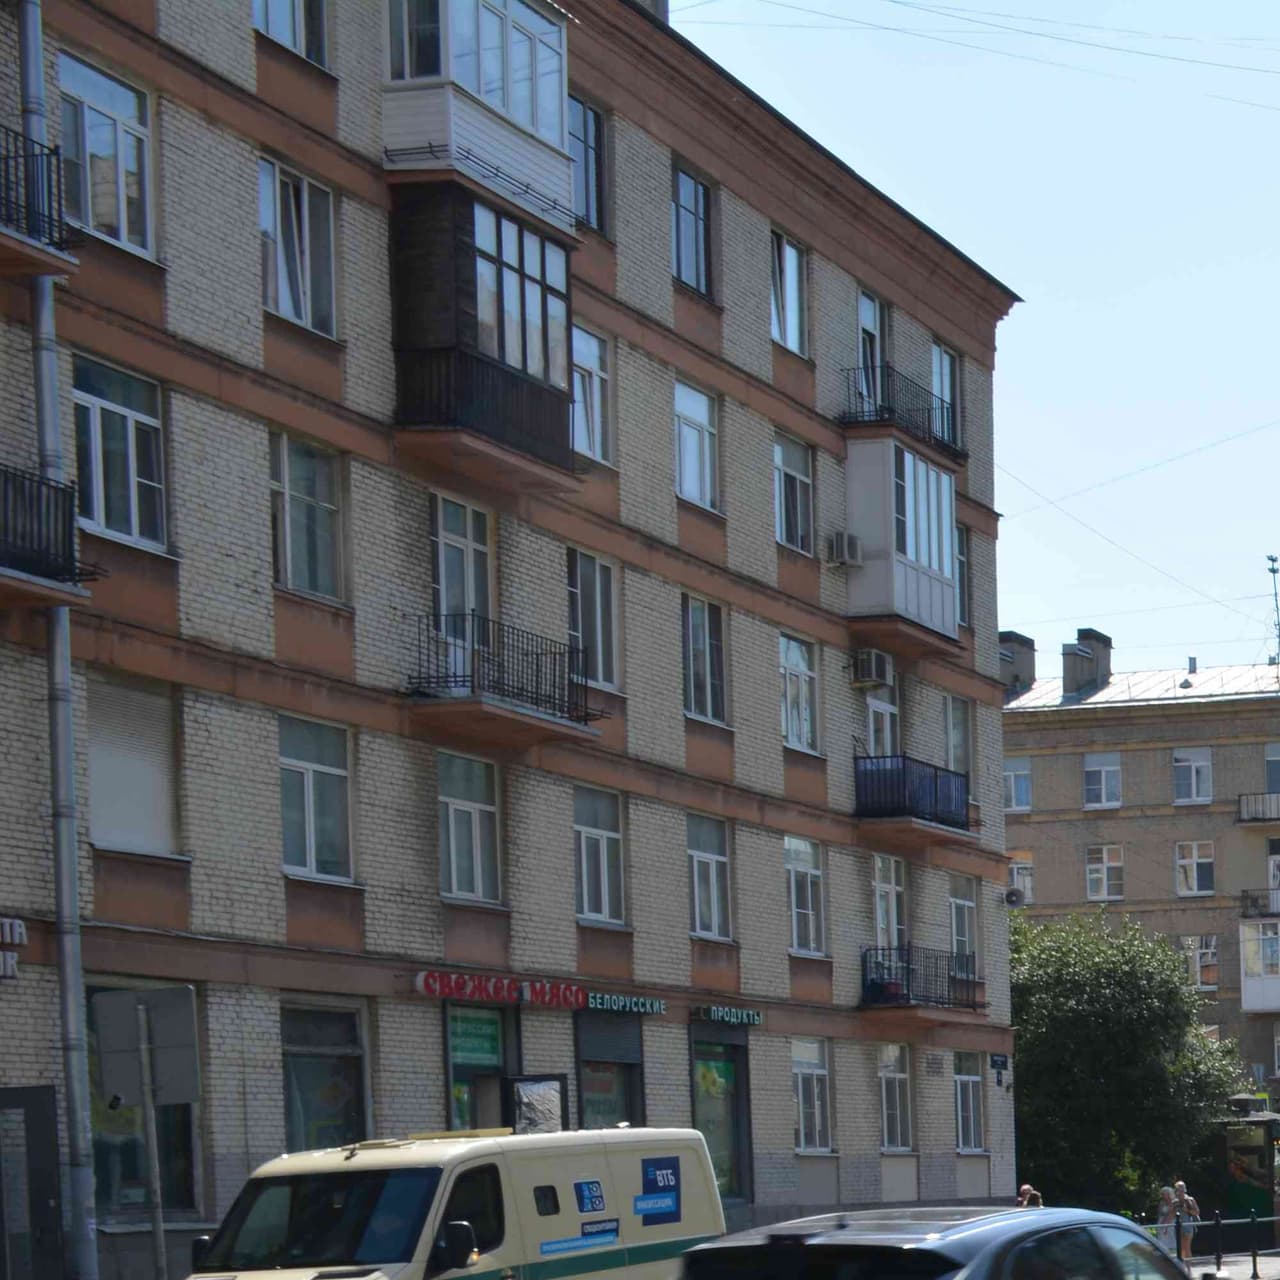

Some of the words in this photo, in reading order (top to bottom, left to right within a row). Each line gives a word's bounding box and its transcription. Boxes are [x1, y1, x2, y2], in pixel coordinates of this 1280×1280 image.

[527, 979, 587, 1009] МЯСО
[588, 992, 667, 1015] БЕЛОРУССКИЕ
[711, 1005, 763, 1025] ПРОДУКТЫ
[656, 1169, 676, 1187] ВТБ
